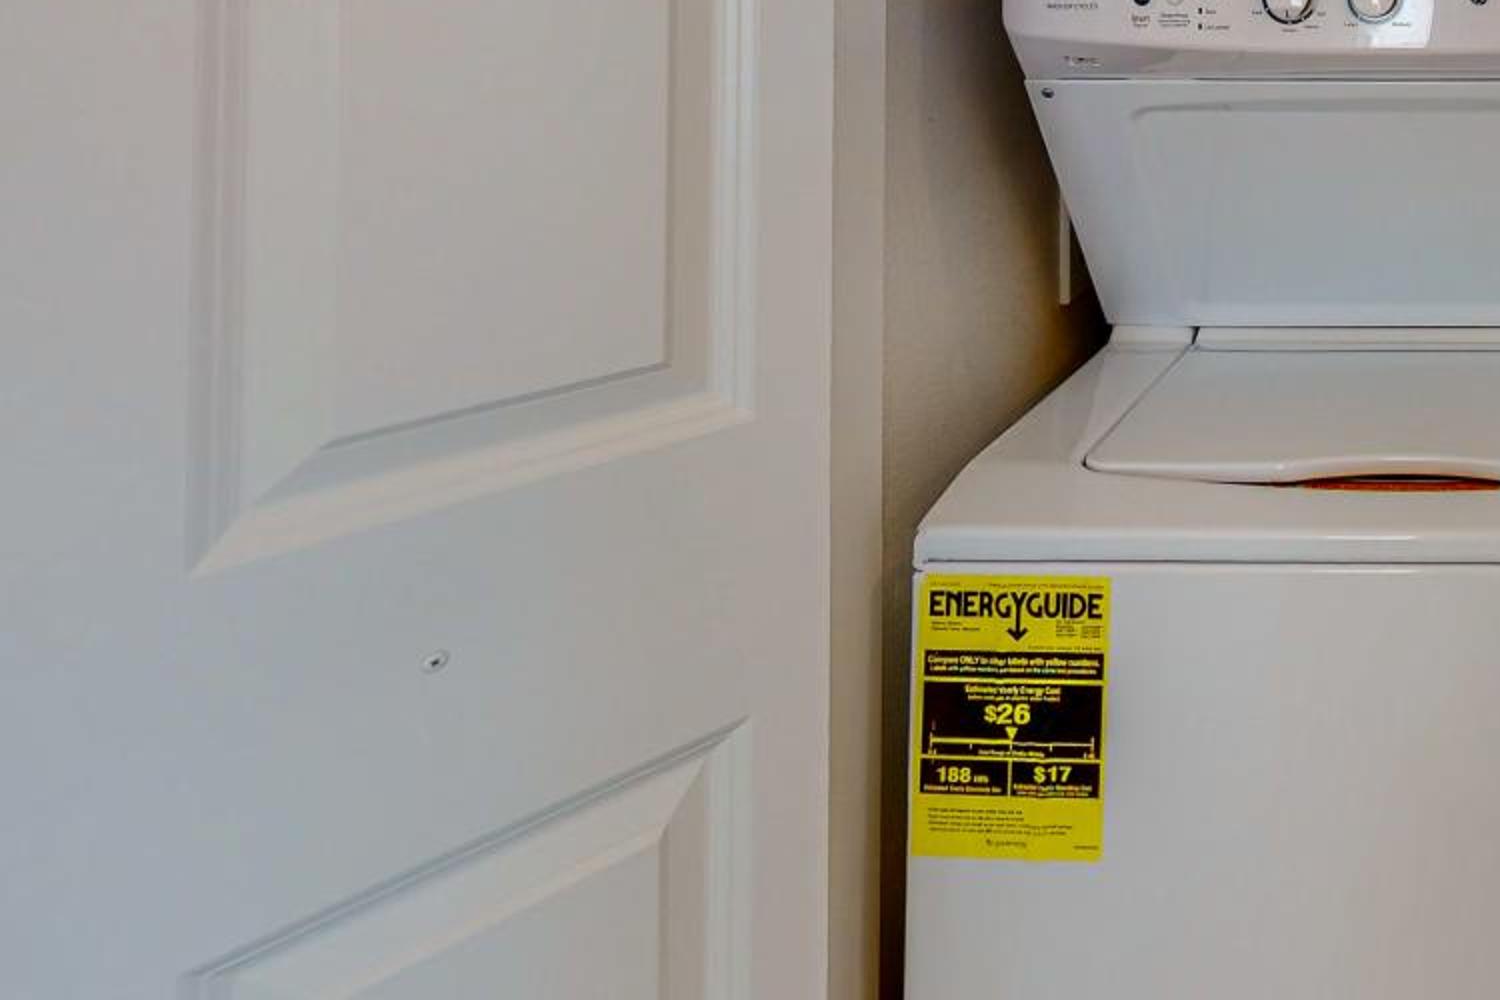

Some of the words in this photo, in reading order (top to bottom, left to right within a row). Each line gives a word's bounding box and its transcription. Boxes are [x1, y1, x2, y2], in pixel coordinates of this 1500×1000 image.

[929, 590, 1104, 620] ENERGYGUIDE
[960, 655, 979, 665] ONLY
[1046, 657, 1067, 667] yellow
[1019, 686, 1044, 697] Energy
[984, 703, 1031, 725] $26
[936, 766, 972, 783] 188
[1033, 766, 1073, 783] $17
